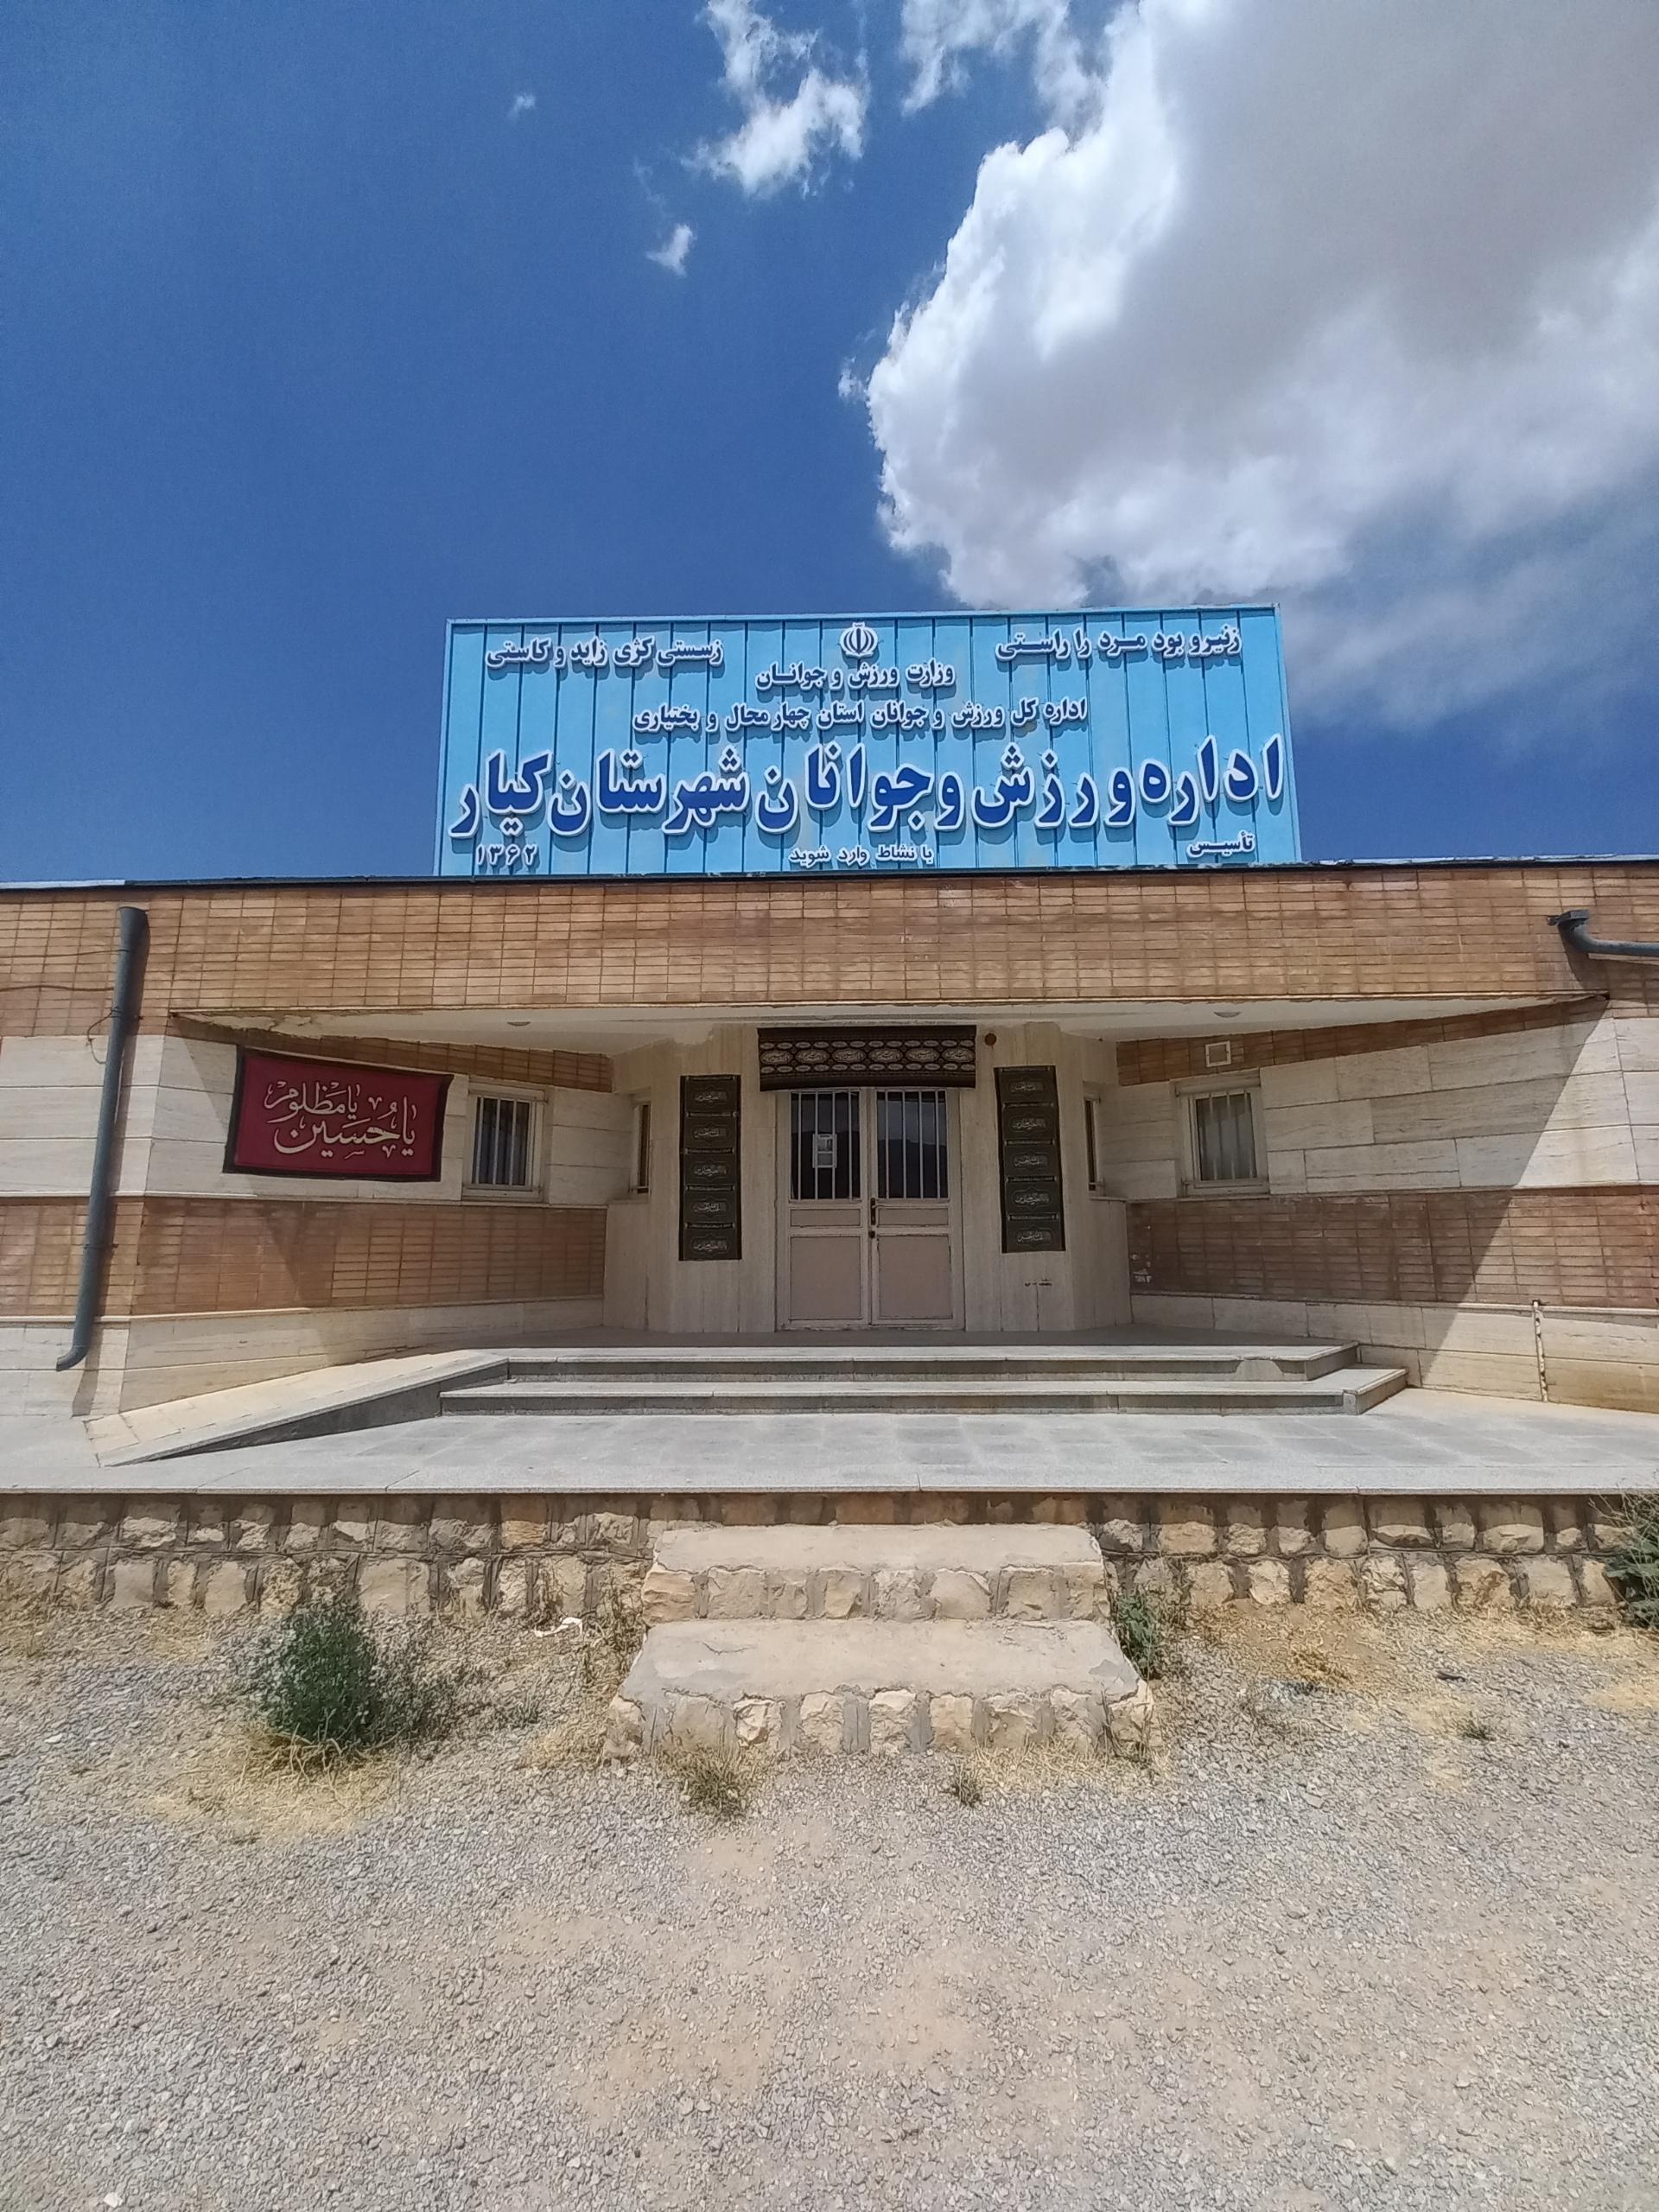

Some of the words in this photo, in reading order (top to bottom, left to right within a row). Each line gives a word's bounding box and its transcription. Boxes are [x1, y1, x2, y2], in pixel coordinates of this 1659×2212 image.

[486, 637, 551, 667] کاستی
[553, 646, 567, 667] و
[570, 636, 607, 665] زاید
[995, 628, 1071, 660] راستی
[1073, 628, 1091, 658] را
[1098, 631, 1146, 657] مرد
[1152, 632, 1184, 658] بود
[755, 661, 825, 690] جوانان
[829, 668, 842, 690] و
[848, 662, 899, 689] ورزش
[906, 658, 956, 687] وزارت
[632, 703, 702, 732] بختیاری
[705, 711, 718, 732] و
[725, 702, 770, 730] محال
[771, 702, 811, 731] چهار
[817, 701, 865, 728] استان
[870, 701, 927, 728] جوانان
[932, 709, 946, 729] و
[951, 702, 1005, 728] ورزش
[1010, 697, 1038, 726] کل
[1044, 696, 1087, 724] اداره
[448, 749, 553, 837] کیار
[547, 746, 750, 836] شهرستان
[755, 741, 934, 833] جوانان
[971, 742, 1134, 830] ورزش
[1140, 734, 1284, 826] اداره
[933, 772, 965, 830] و
[475, 842, 537, 865] ۱۳۶۲
[789, 847, 831, 868] شوید
[836, 846, 869, 866] وارد
[876, 844, 917, 862] نشاط
[919, 844, 934, 864] با
